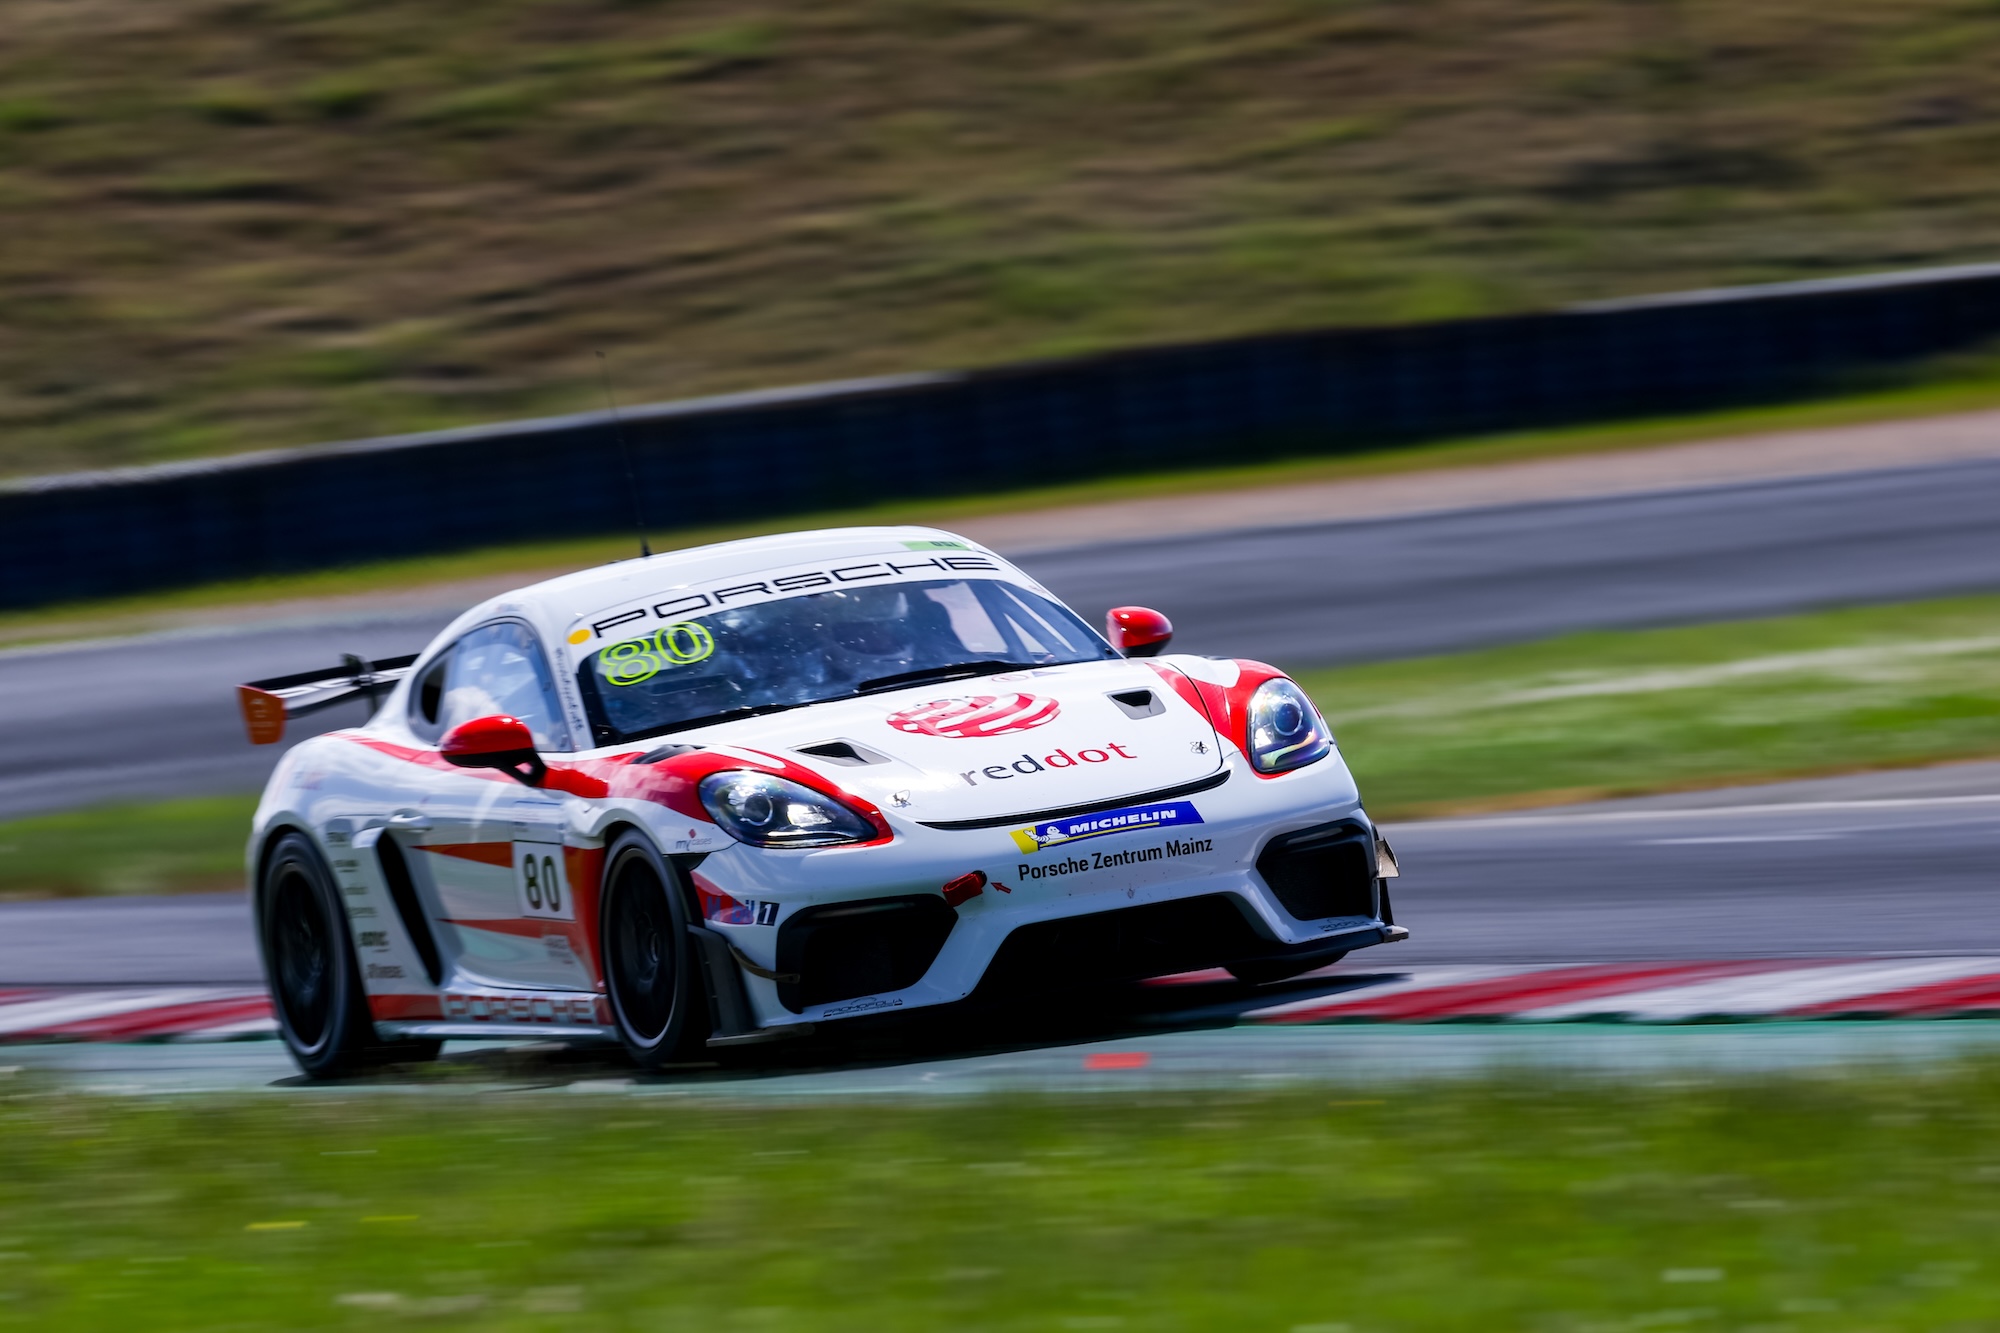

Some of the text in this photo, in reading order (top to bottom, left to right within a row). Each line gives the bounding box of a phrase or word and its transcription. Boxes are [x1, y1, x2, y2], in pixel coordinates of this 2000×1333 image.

[592, 557, 1000, 638] PORSCHE
[599, 622, 714, 686] 80
[1069, 809, 1178, 835] MICHELIN
[1018, 838, 1213, 881] Porsche Zentrum Mainz
[523, 853, 561, 912] 80
[706, 895, 755, 922] Mbil
[442, 994, 596, 1024] PORSCHE
